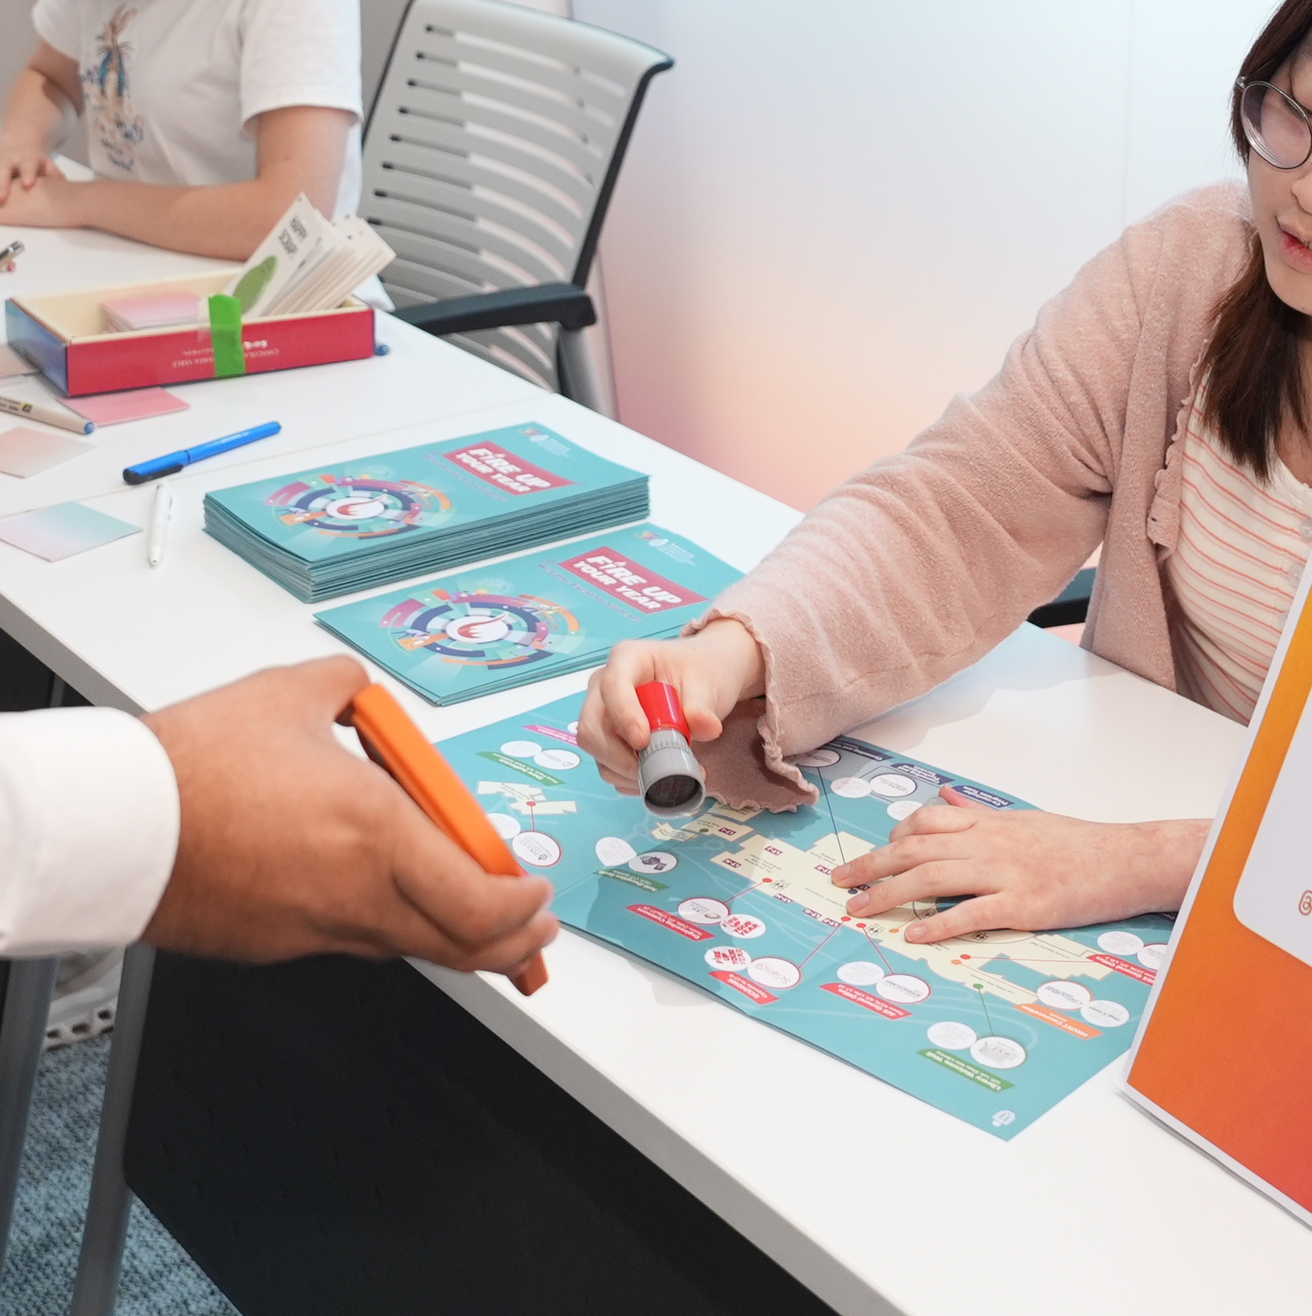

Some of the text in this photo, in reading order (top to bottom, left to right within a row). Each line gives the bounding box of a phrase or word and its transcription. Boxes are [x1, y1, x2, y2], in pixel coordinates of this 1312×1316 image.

[455, 452, 495, 474] YOUR
[490, 473, 531, 493] YEAR
[468, 448, 522, 474] FIRE
[515, 473, 551, 488] UP
[573, 561, 662, 610] YOUR YEAR
[586, 556, 682, 604] FIRE UP
